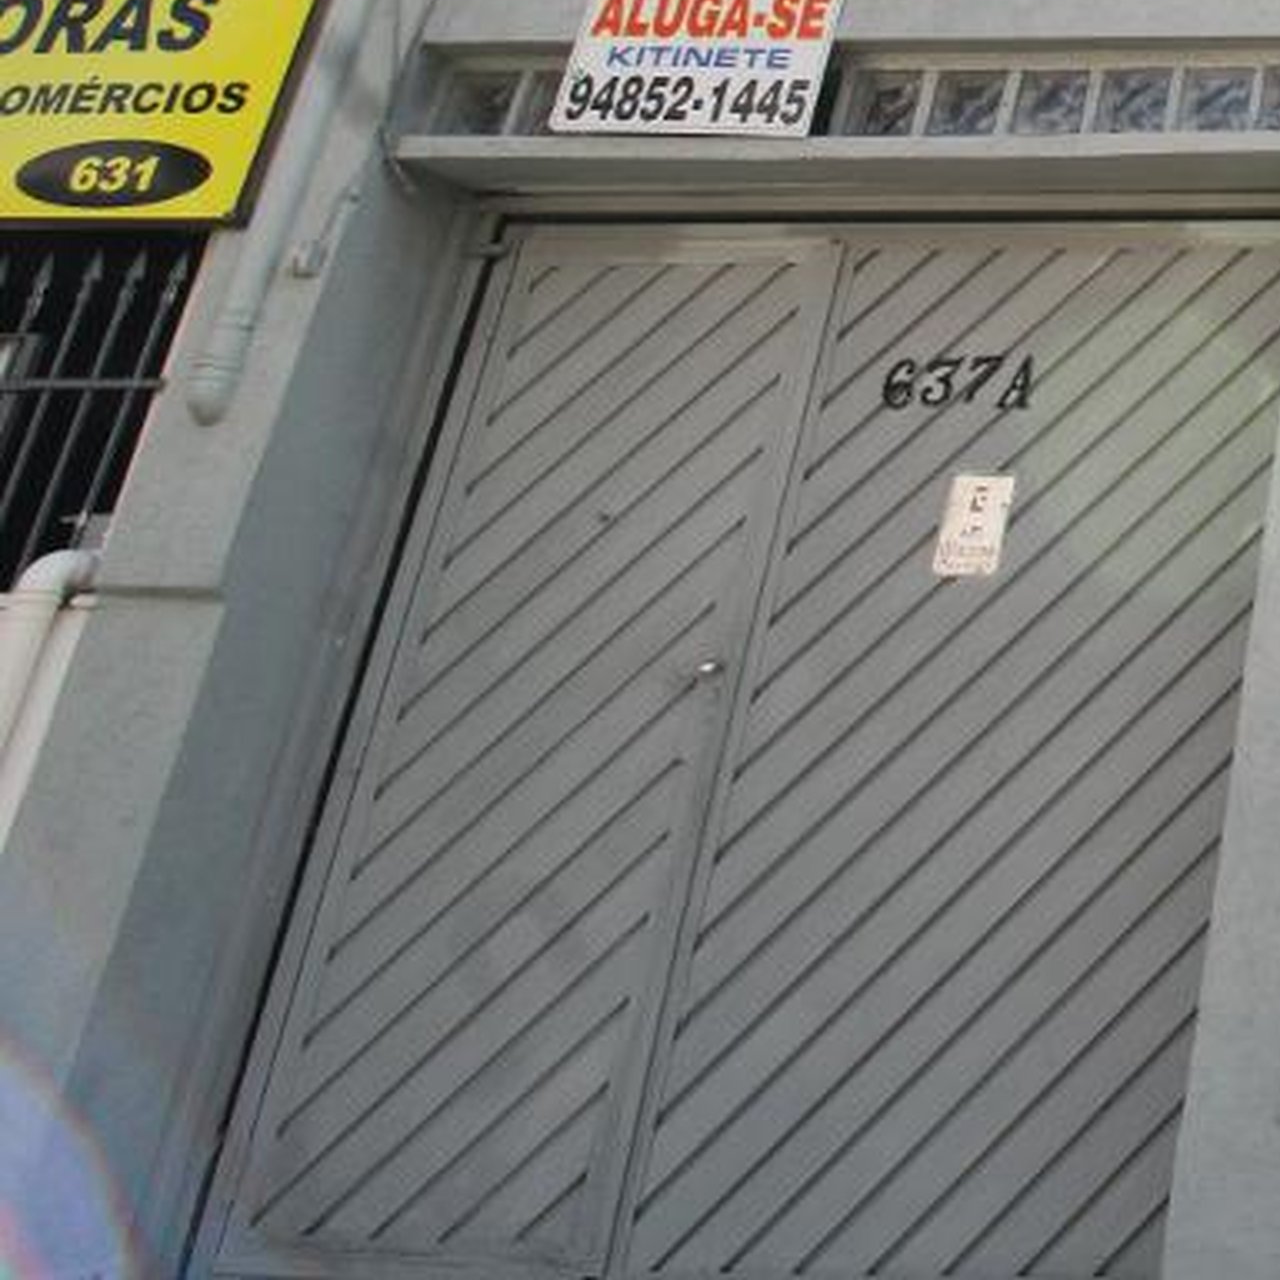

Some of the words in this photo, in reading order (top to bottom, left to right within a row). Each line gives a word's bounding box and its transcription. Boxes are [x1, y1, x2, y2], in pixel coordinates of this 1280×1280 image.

[606, 45, 793, 70] KITINETE
[565, 74, 811, 125] 94852-1445
[68, 156, 160, 193] 631
[882, 354, 1033, 410] 637A
